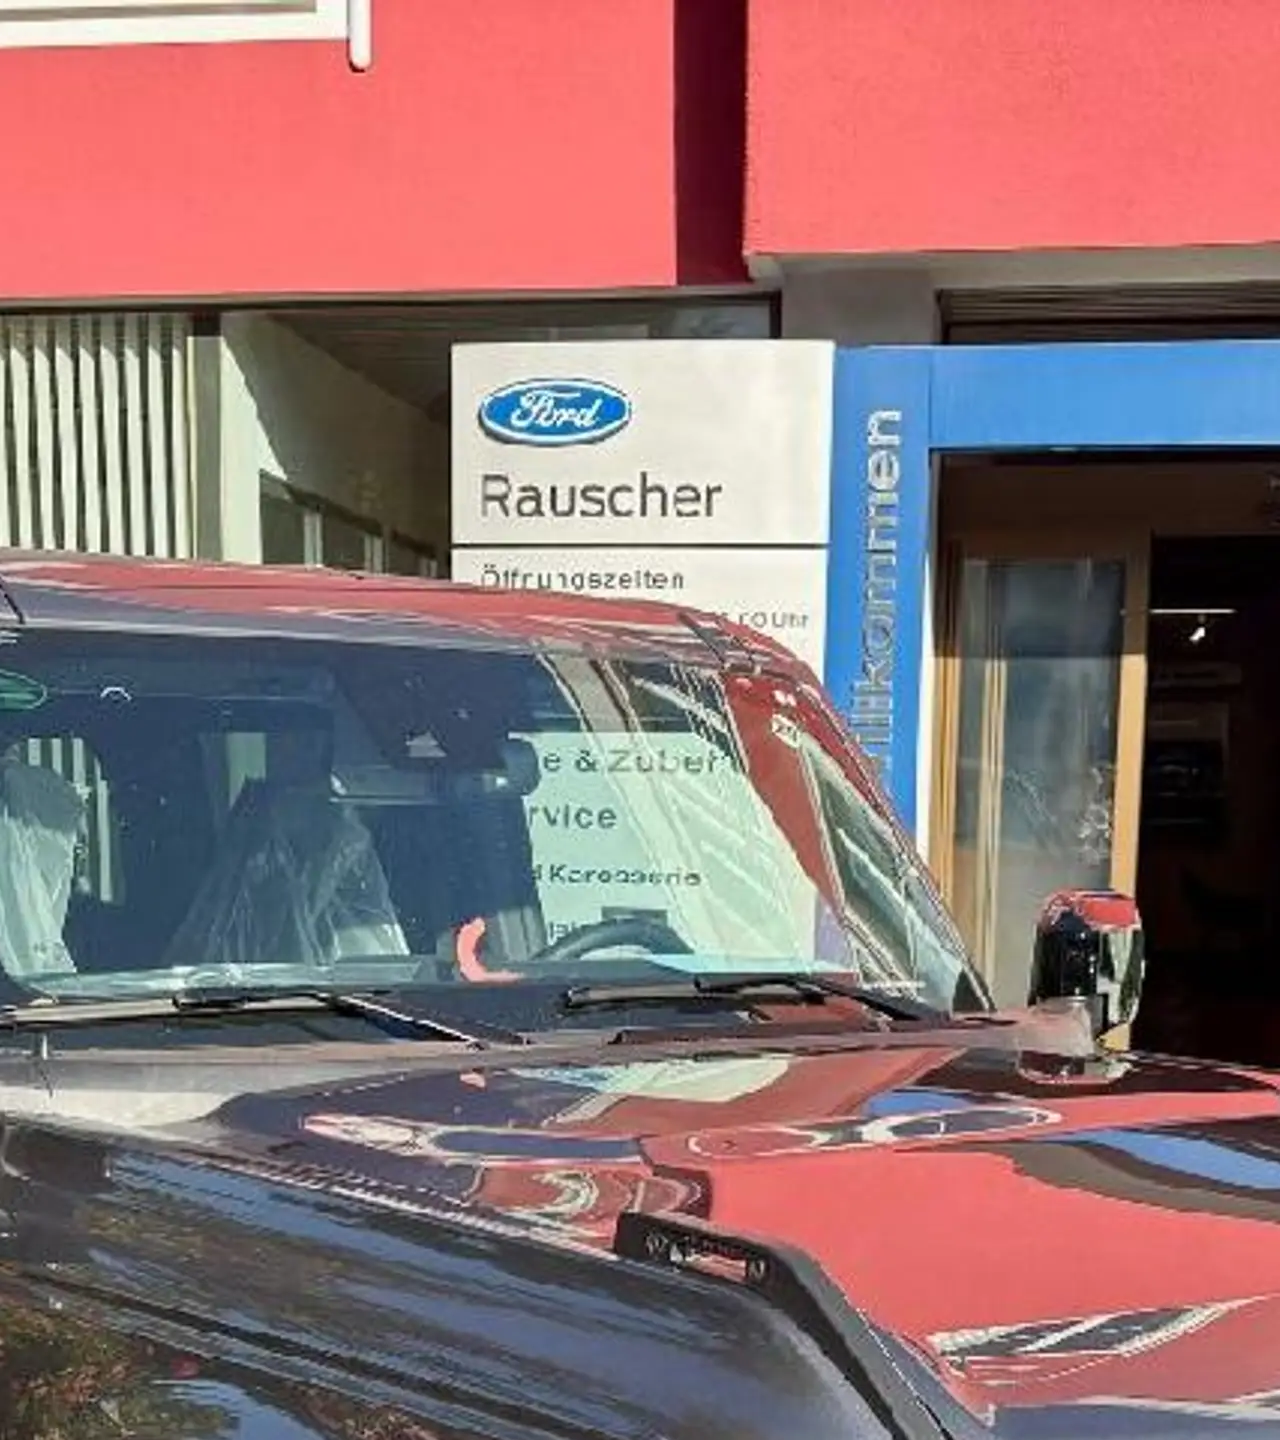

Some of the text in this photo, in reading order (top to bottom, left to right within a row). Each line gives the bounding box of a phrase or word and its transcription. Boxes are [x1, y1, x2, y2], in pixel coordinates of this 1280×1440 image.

[509, 389, 604, 428] Ford
[480, 471, 723, 518] Rauscher
[851, 408, 902, 790] illkommen
[574, 750, 597, 772] &
[528, 804, 618, 829] rvice
